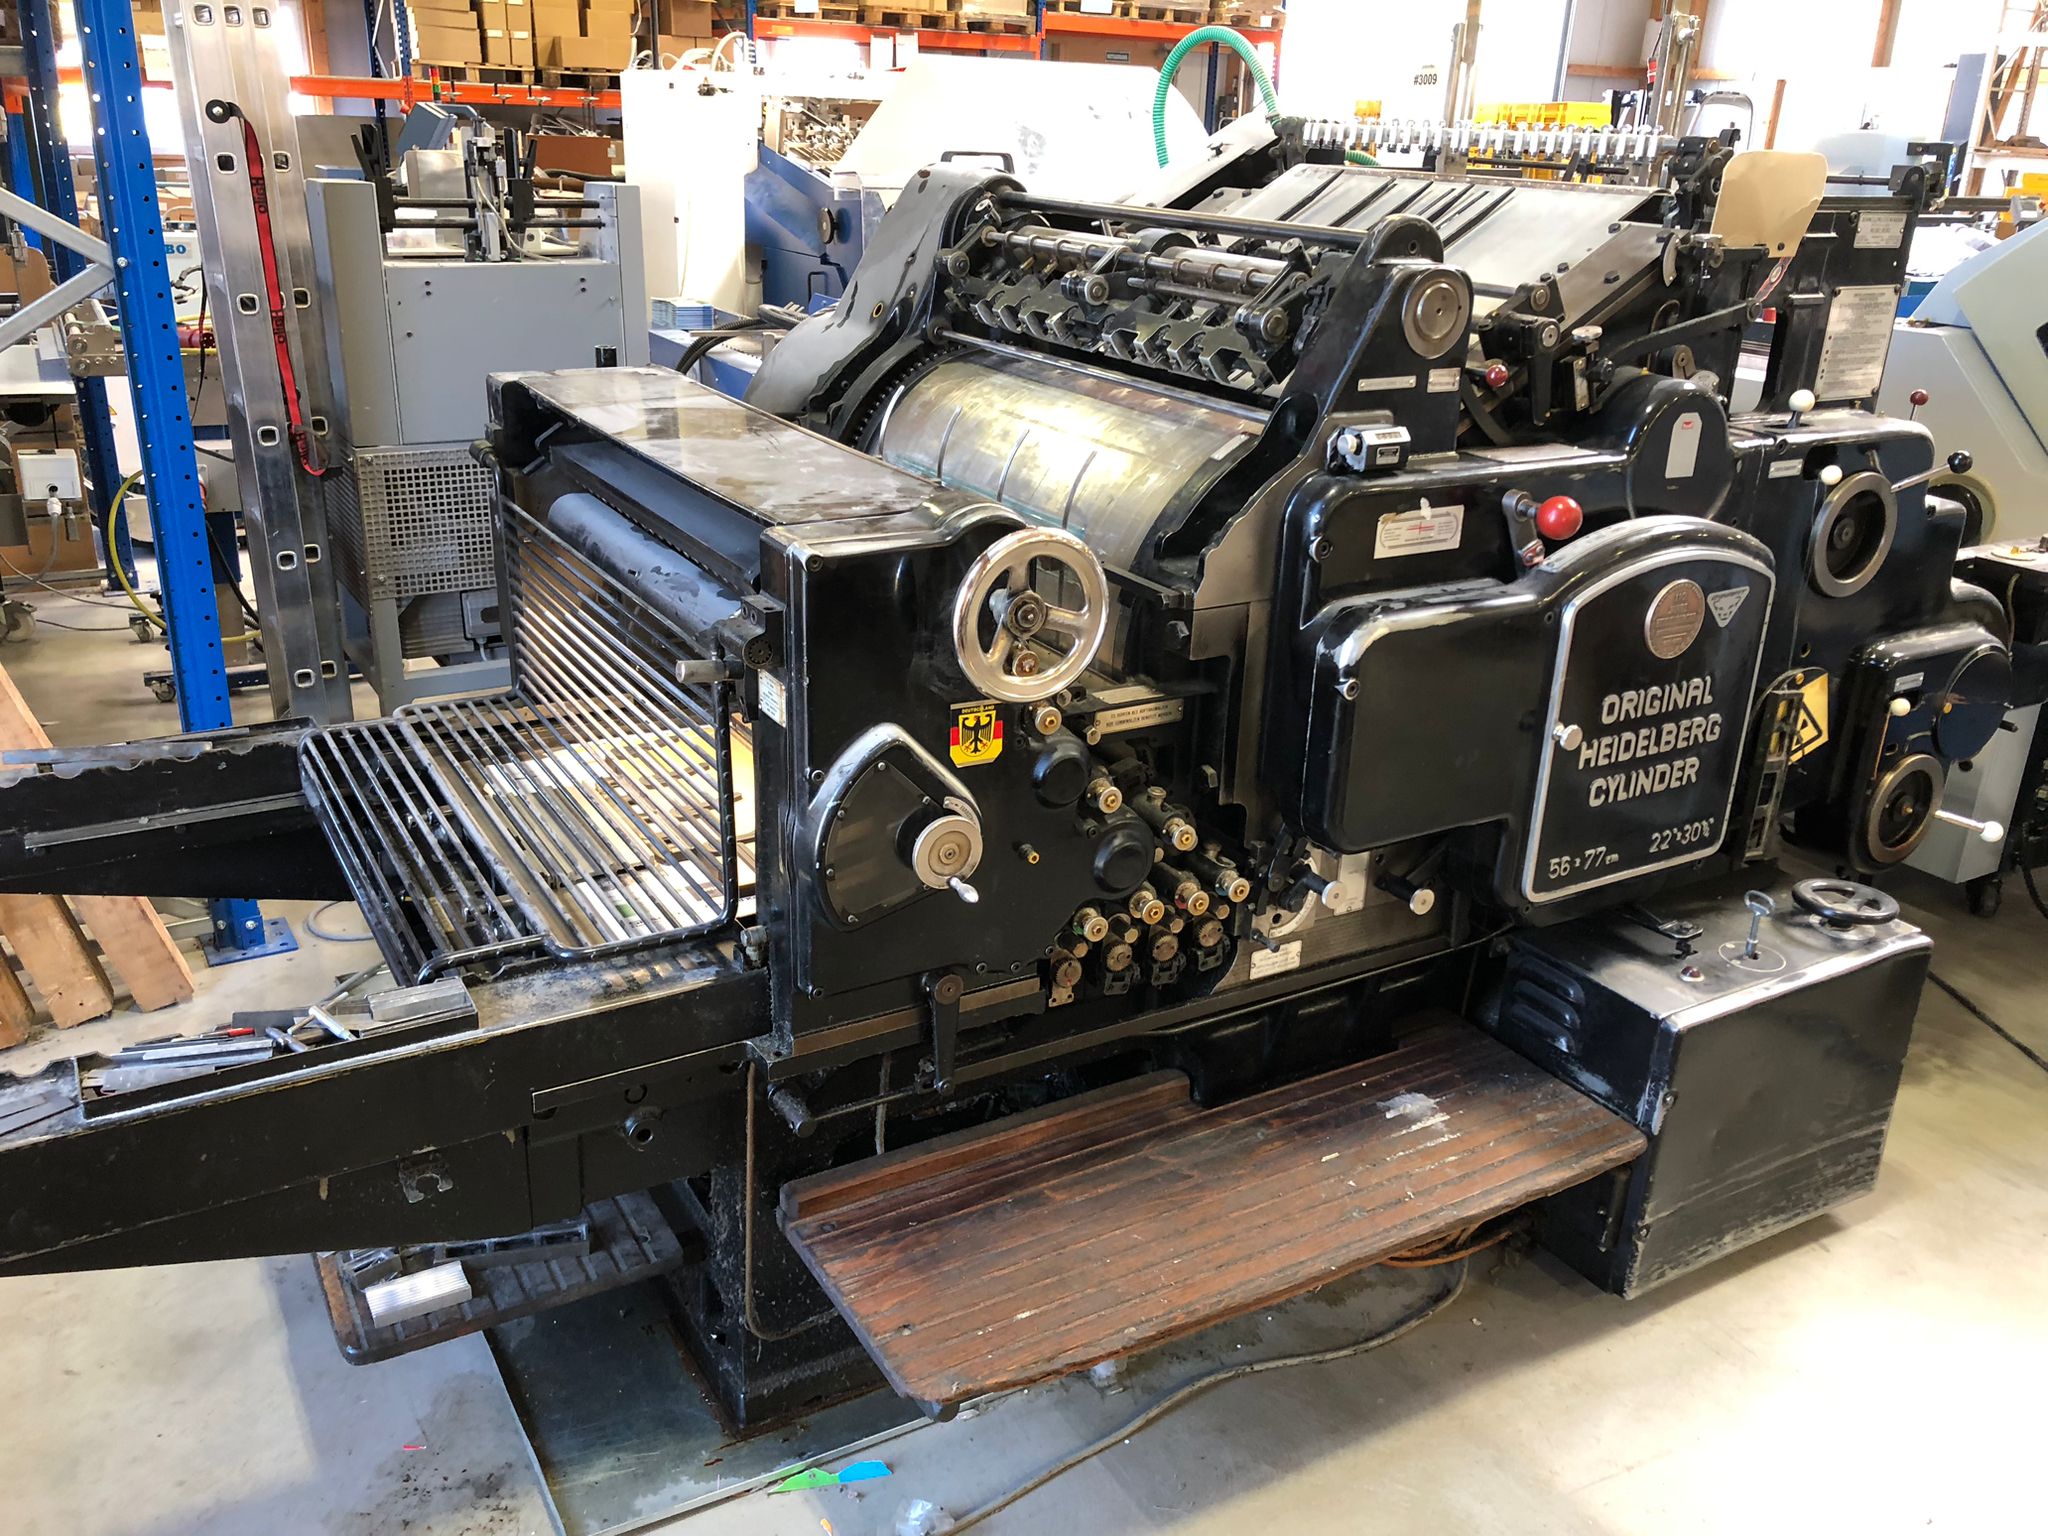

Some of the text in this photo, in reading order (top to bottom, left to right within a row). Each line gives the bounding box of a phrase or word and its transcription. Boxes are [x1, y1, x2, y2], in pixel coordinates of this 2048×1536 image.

[1413, 73, 1437, 86] #3009
[961, 705, 995, 714] DEUTSCLAND
[1601, 675, 1713, 725] ORIGINAL
[1578, 713, 1722, 770] HEIDELBERG
[1588, 756, 1700, 807] CYLINDER
[1548, 855, 1571, 879] 56
